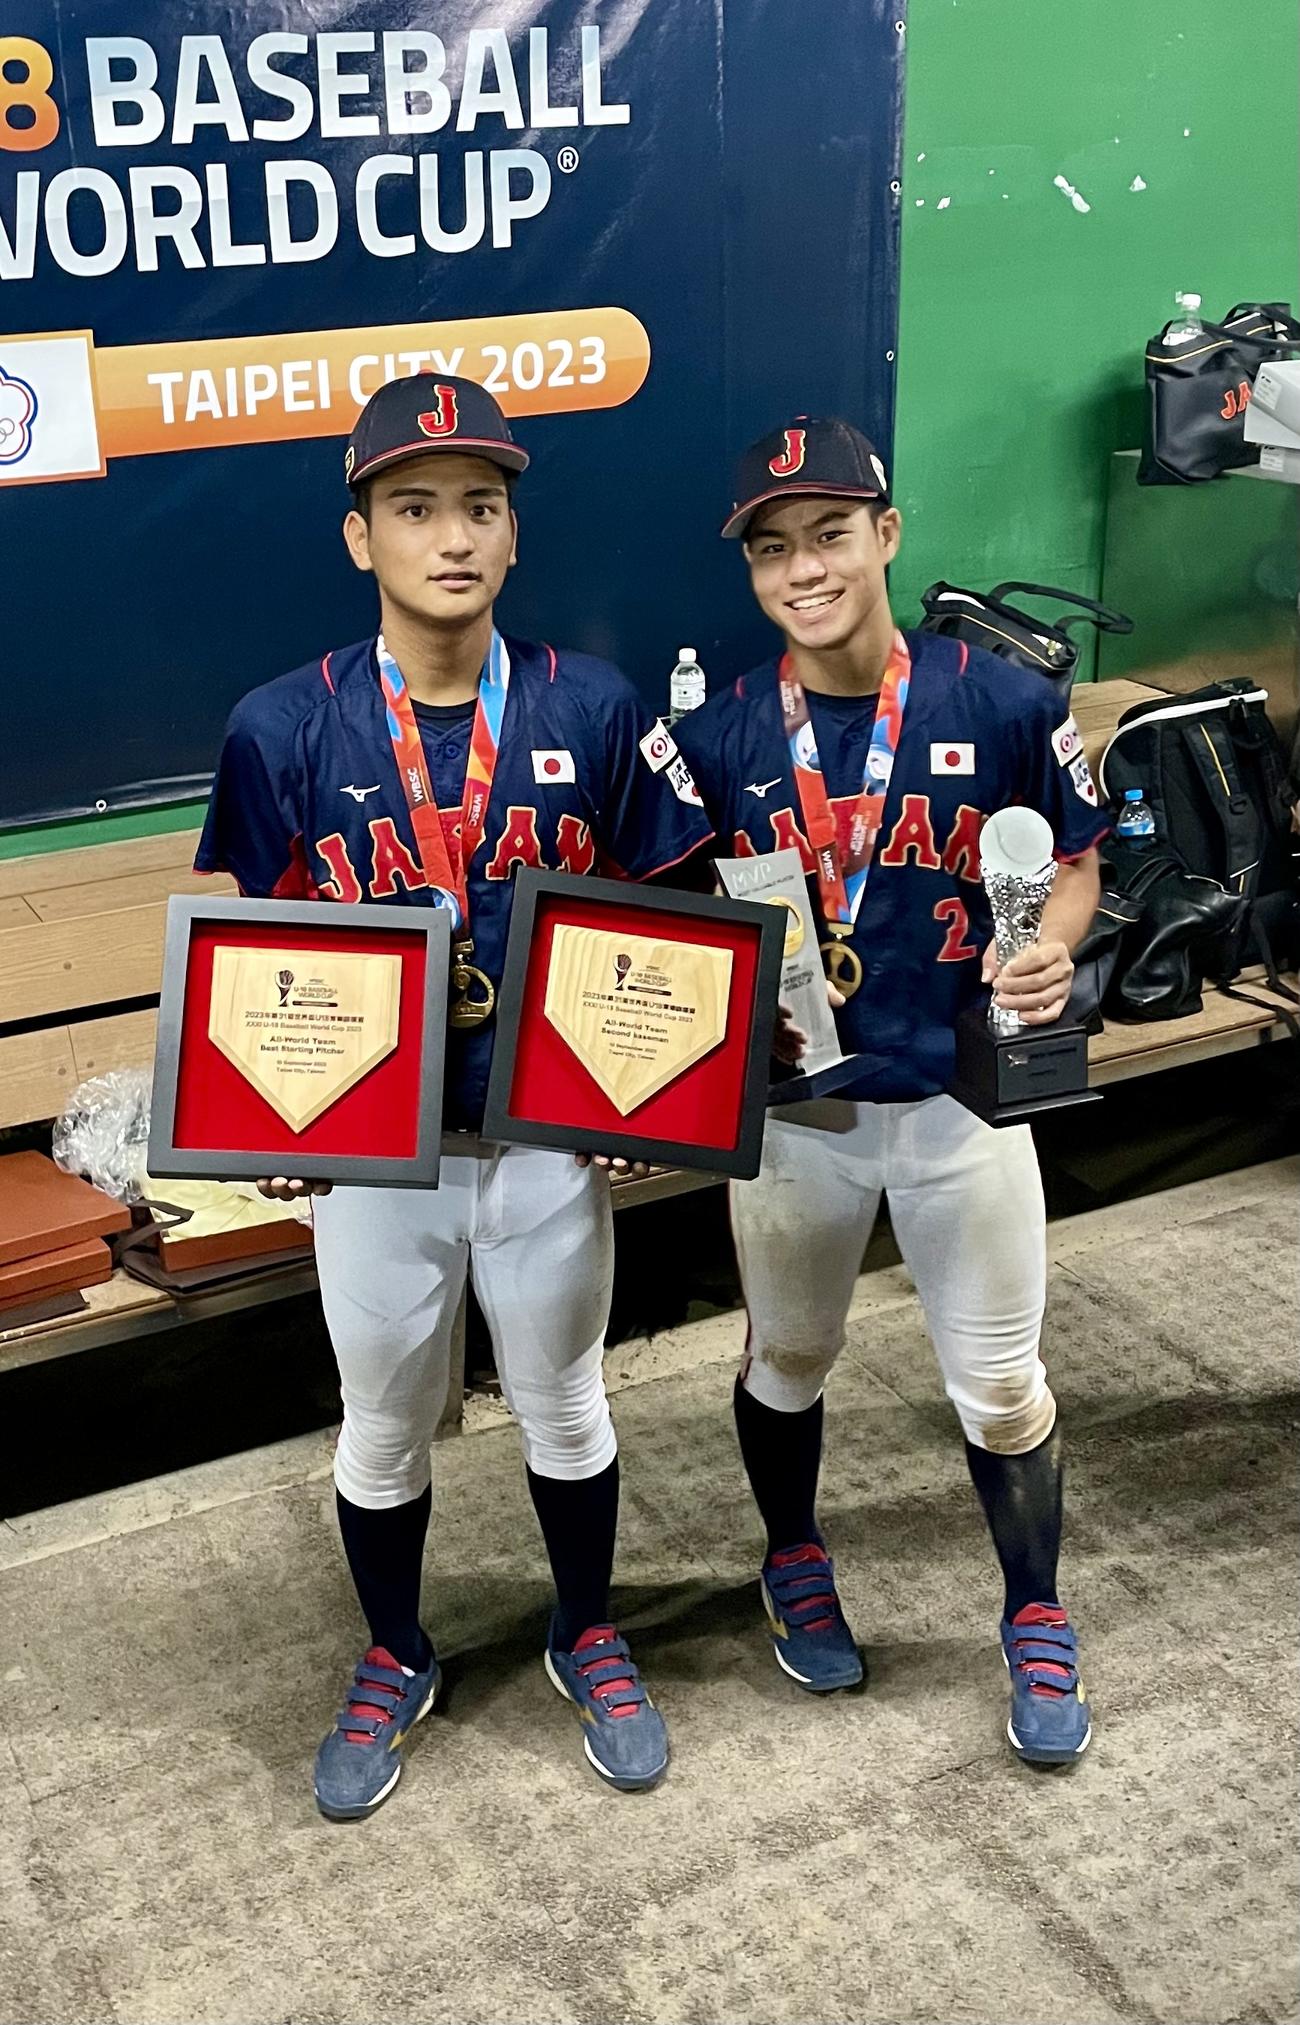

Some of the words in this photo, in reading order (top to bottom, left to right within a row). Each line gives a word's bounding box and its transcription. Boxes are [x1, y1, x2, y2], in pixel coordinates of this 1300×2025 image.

[0, 36, 60, 151] 8
[85, 25, 630, 147] BASEBALL
[147, 359, 331, 424] TAIPEI
[480, 336, 607, 393] 2023
[417, 384, 459, 437] J
[768, 429, 806, 477] J
[407, 767, 424, 803] WBSC
[468, 793, 483, 827] WBSC
[734, 794, 982, 883] AAN
[732, 862, 770, 890] MVP
[821, 850, 836, 882] WBSC
[933, 897, 977, 962] 2
[312, 1037, 336, 1045] Team
[601, 1027, 631, 1038] Second
[645, 1025, 668, 1034] Team
[281, 1045, 313, 1054] Starting
